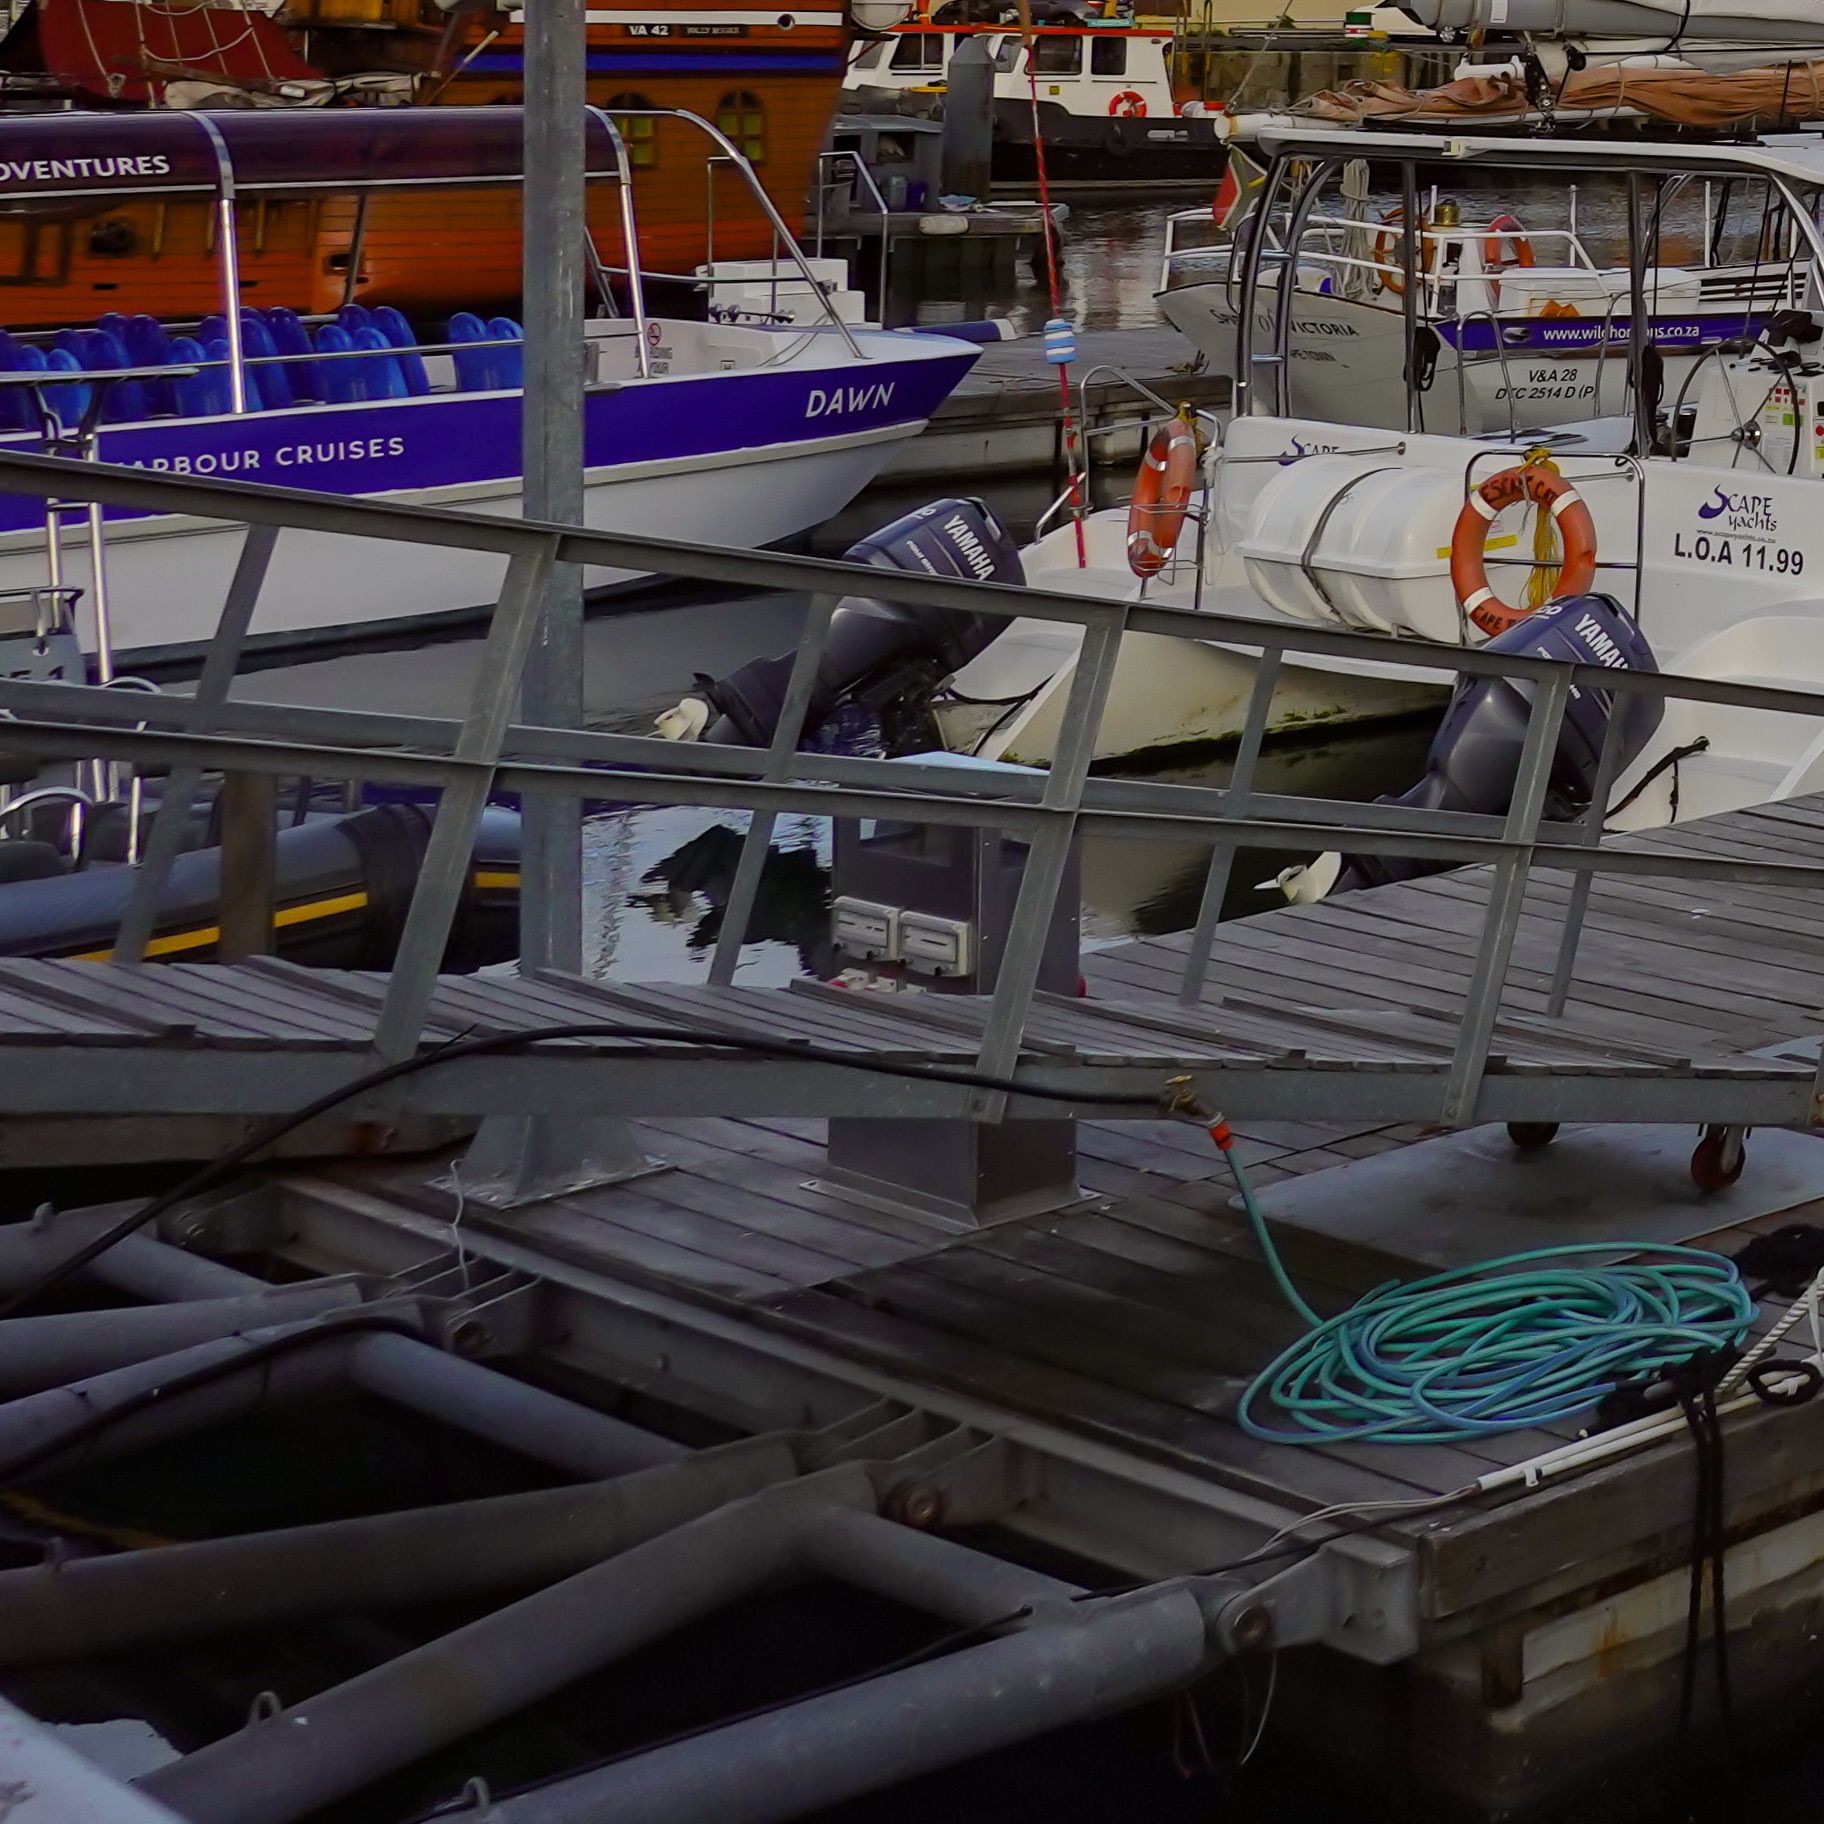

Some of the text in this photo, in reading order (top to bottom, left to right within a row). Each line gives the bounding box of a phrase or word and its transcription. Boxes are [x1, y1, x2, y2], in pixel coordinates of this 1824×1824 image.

[651, 25, 669, 36] 42
[1528, 386, 1561, 400] 2514
[1564, 385, 1576, 399] D
[1578, 384, 1596, 400] (P
[1529, 368, 1578, 383] V&A 28
[805, 381, 896, 418] DAWN
[275, 437, 405, 467] CRUISES
[944, 514, 997, 581] YAMAHA
[1674, 532, 1803, 576] L.O.A 11.99
[1574, 613, 1629, 669] YAMA
